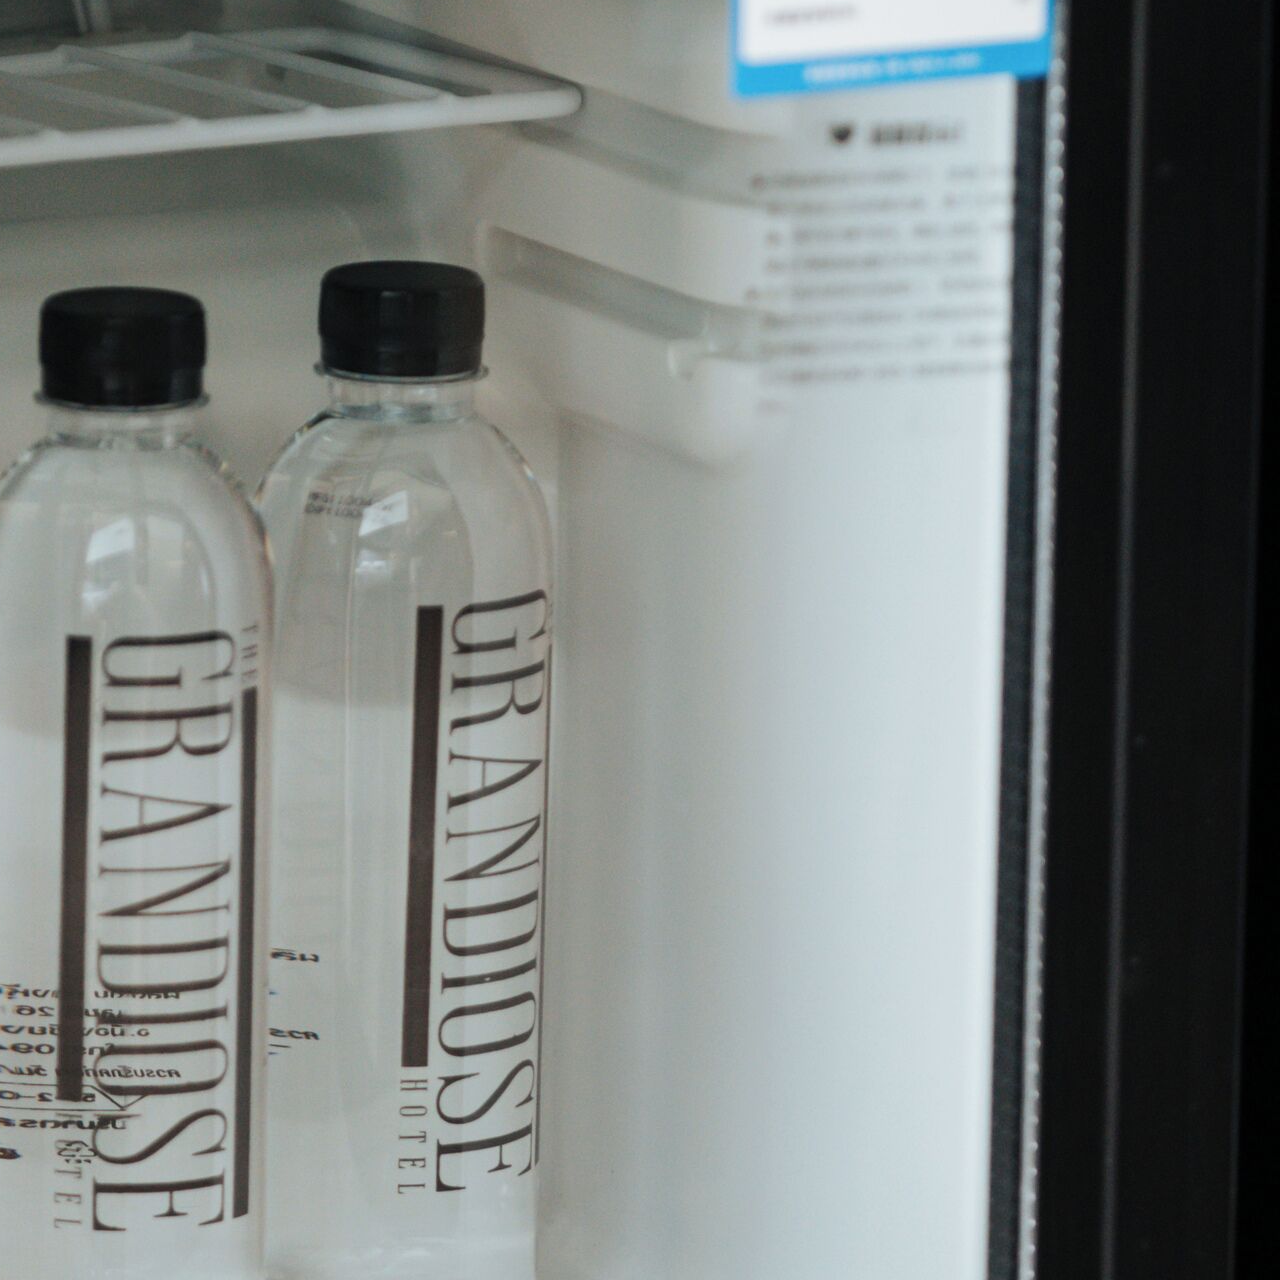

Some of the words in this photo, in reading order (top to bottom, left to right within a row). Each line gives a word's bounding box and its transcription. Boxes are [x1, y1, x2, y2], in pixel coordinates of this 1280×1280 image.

[92, 629, 236, 1232] GRANDIOSE
[397, 1078, 429, 1195] HOTEL
[436, 588, 547, 1193] GRANDIOSE
